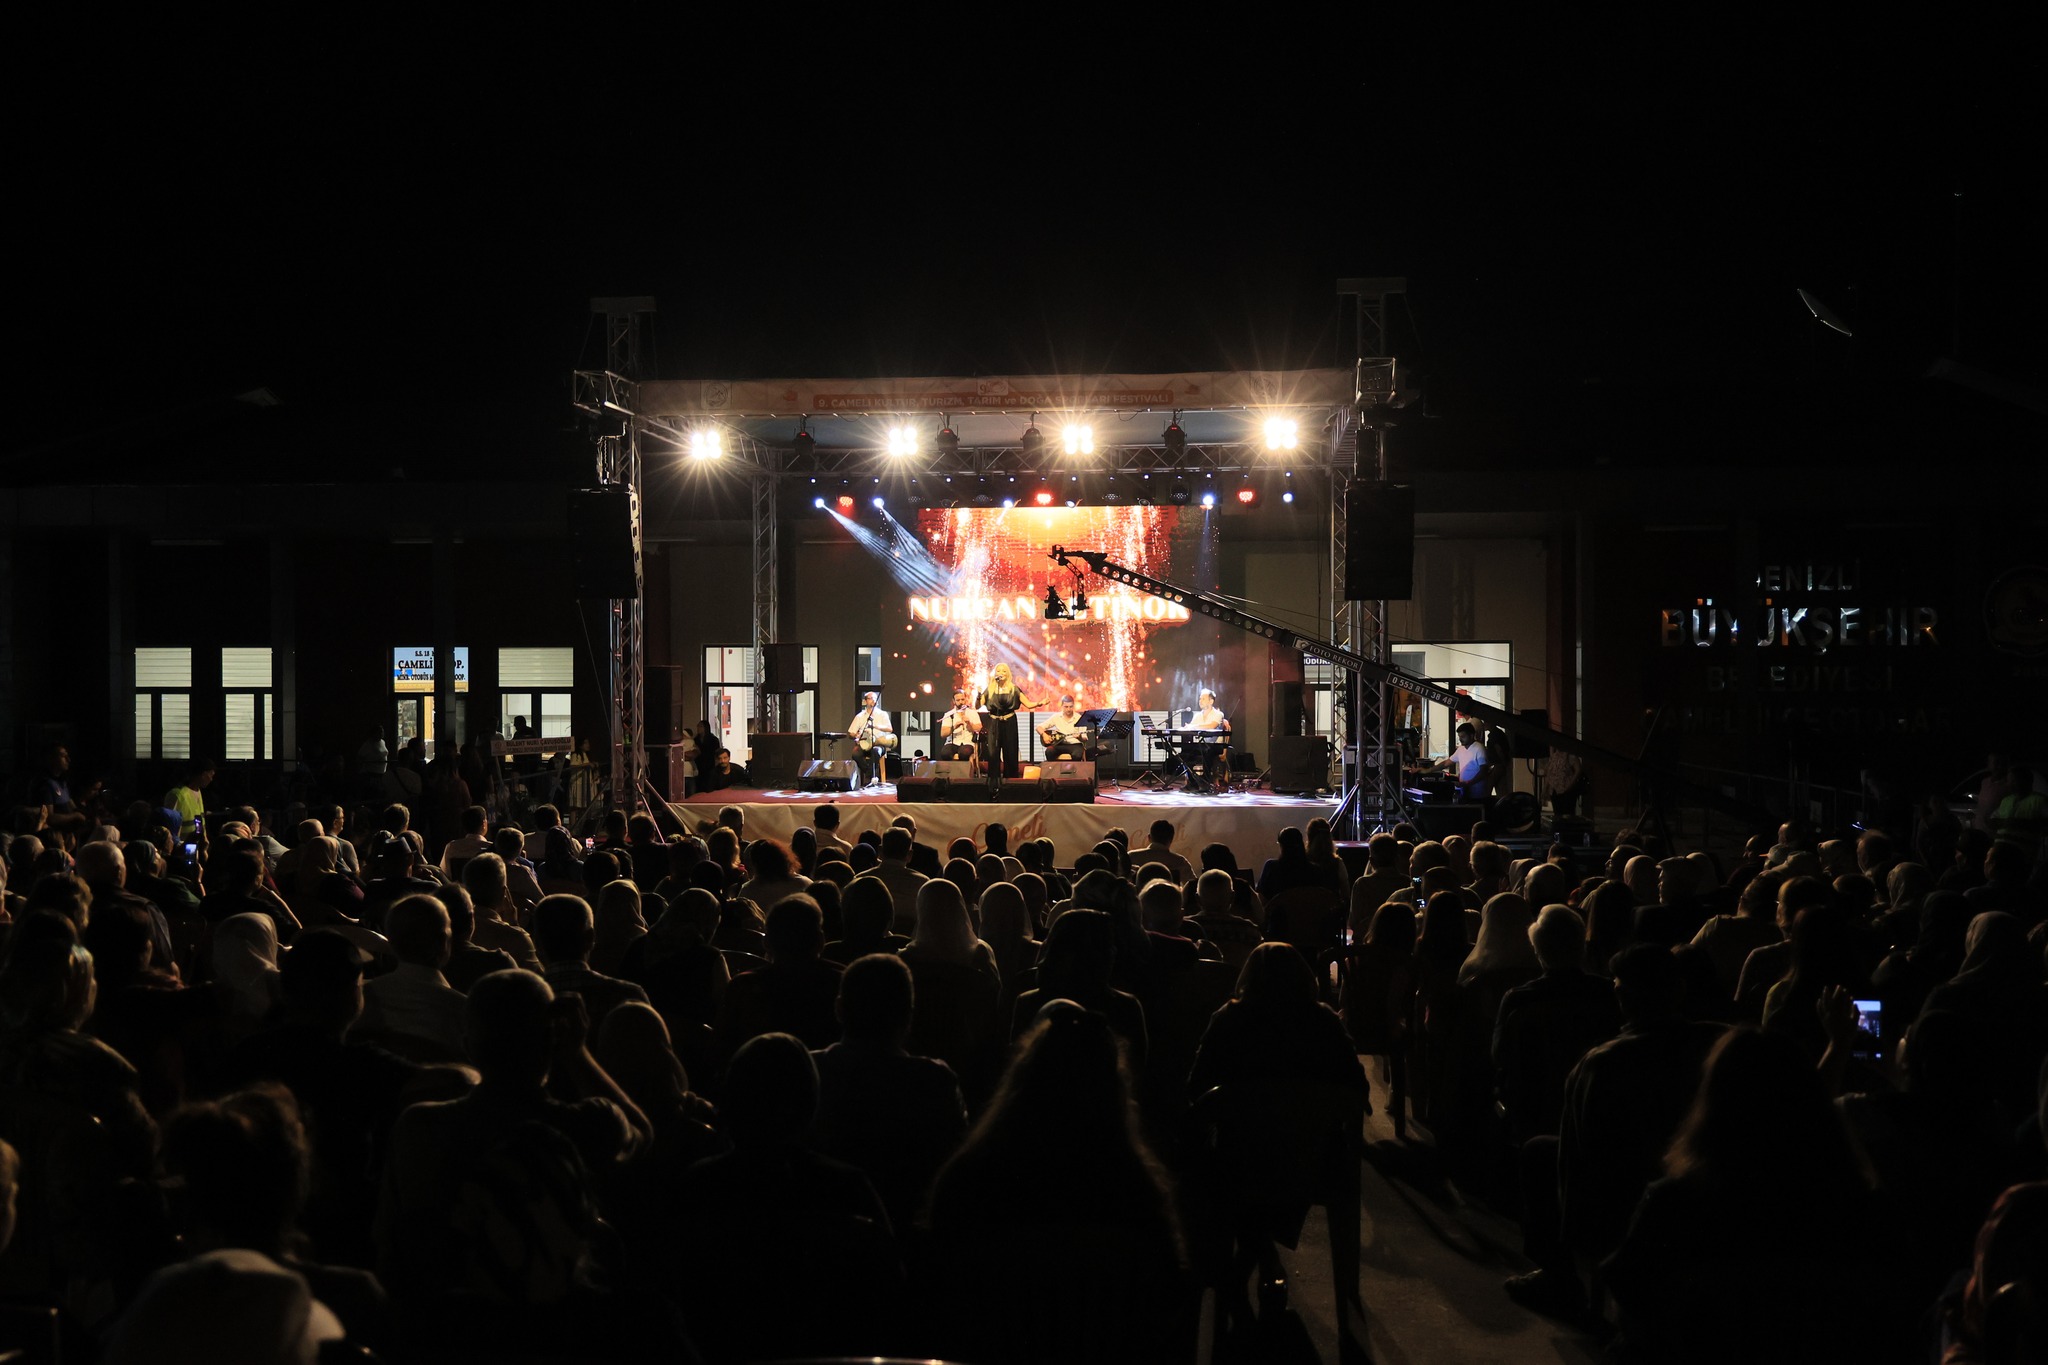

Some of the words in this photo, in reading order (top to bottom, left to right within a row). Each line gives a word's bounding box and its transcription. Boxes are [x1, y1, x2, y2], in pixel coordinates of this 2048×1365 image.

[967, 396, 1001, 406] TARIM
[398, 657, 434, 672] ÇAMELİ
[1309, 644, 1331, 659] FOTO
[1332, 653, 1360, 669] REKOR
[1392, 676, 1398, 684] 0
[1399, 680, 1414, 690] 553
[1415, 686, 1430, 697] 811
[1431, 692, 1441, 701] 38
[1442, 696, 1453, 706] 48
